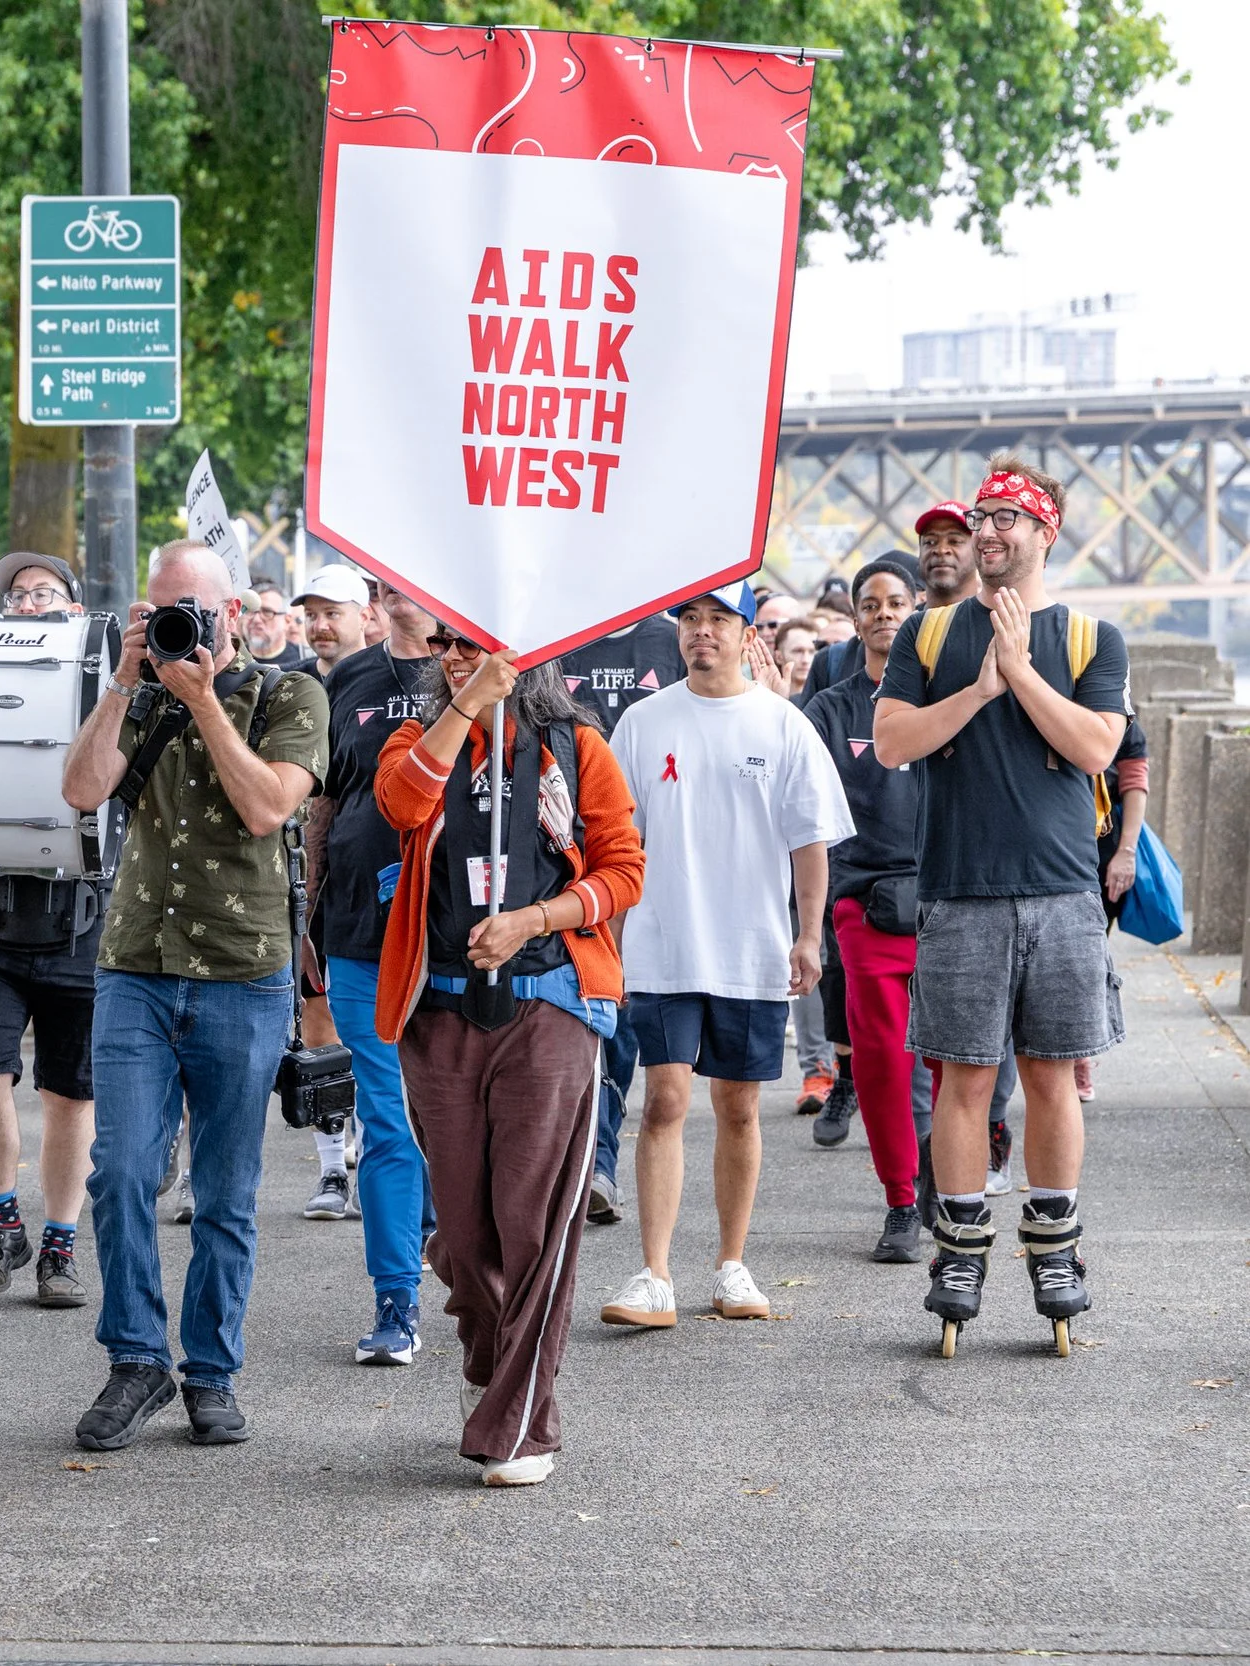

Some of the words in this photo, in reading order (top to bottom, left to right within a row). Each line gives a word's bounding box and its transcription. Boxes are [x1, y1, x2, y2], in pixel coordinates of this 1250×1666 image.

[61, 275, 97, 291] Naito
[102, 275, 163, 292] Parkway
[471, 246, 639, 314] AIDS
[61, 318, 100, 334] Pearl
[106, 318, 160, 334] District
[468, 313, 635, 383] WALK
[62, 368, 97, 384] Steel
[101, 368, 147, 388] Bridge
[62, 385, 94, 402] Path
[462, 381, 627, 444] NORTH
[462, 444, 620, 514] WEST
[591, 674, 635, 690] LIFE
